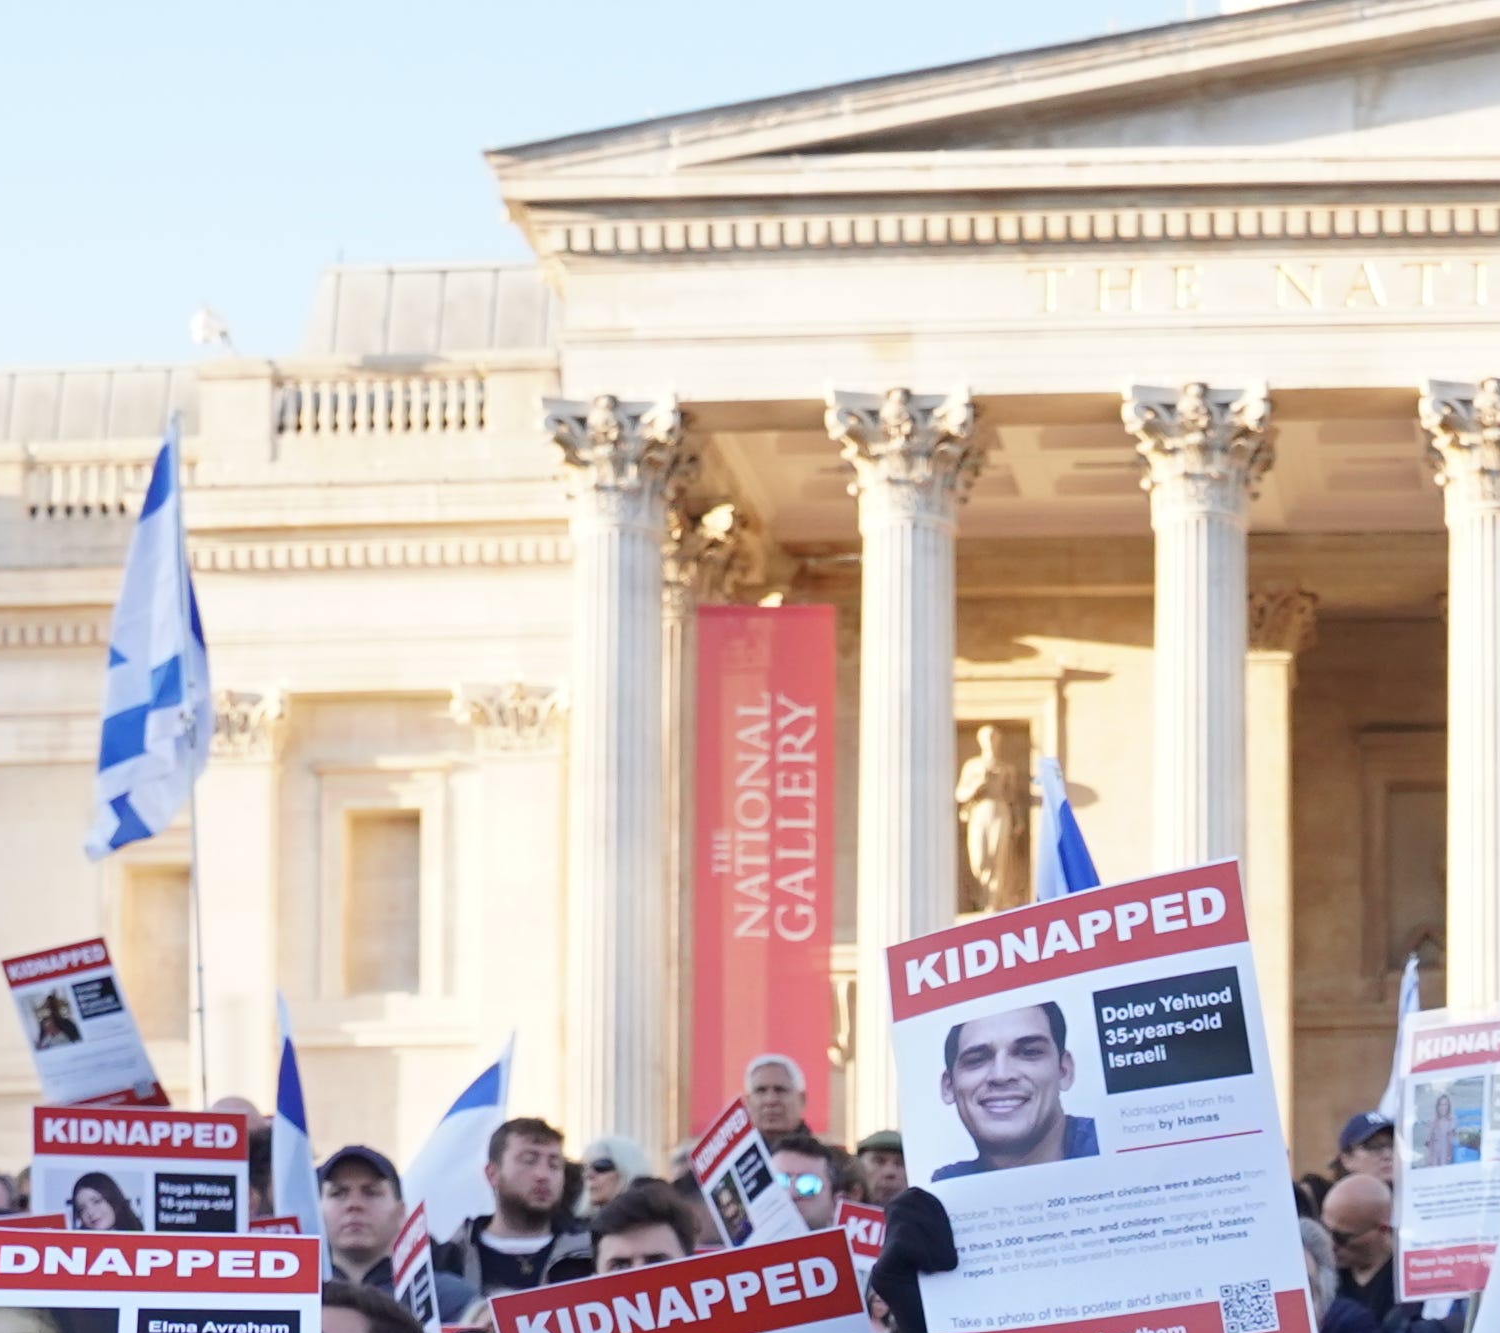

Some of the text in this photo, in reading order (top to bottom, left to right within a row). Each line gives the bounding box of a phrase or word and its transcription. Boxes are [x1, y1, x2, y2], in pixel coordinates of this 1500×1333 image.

[1026, 259, 1205, 313] THE
[734, 692, 771, 939] NATIONAL
[774, 692, 817, 942] GALLERY
[905, 886, 1228, 995] KIDNAPPED
[7, 944, 106, 981] KIDNAPPED
[1102, 986, 1233, 1023] Dolev Yehuod
[1106, 1012, 1222, 1046] 35-years-old
[1109, 1045, 1167, 1069] Israeli
[43, 1117, 237, 1148] KIDNAPPED
[1158, 1112, 1220, 1132] by Hamas
